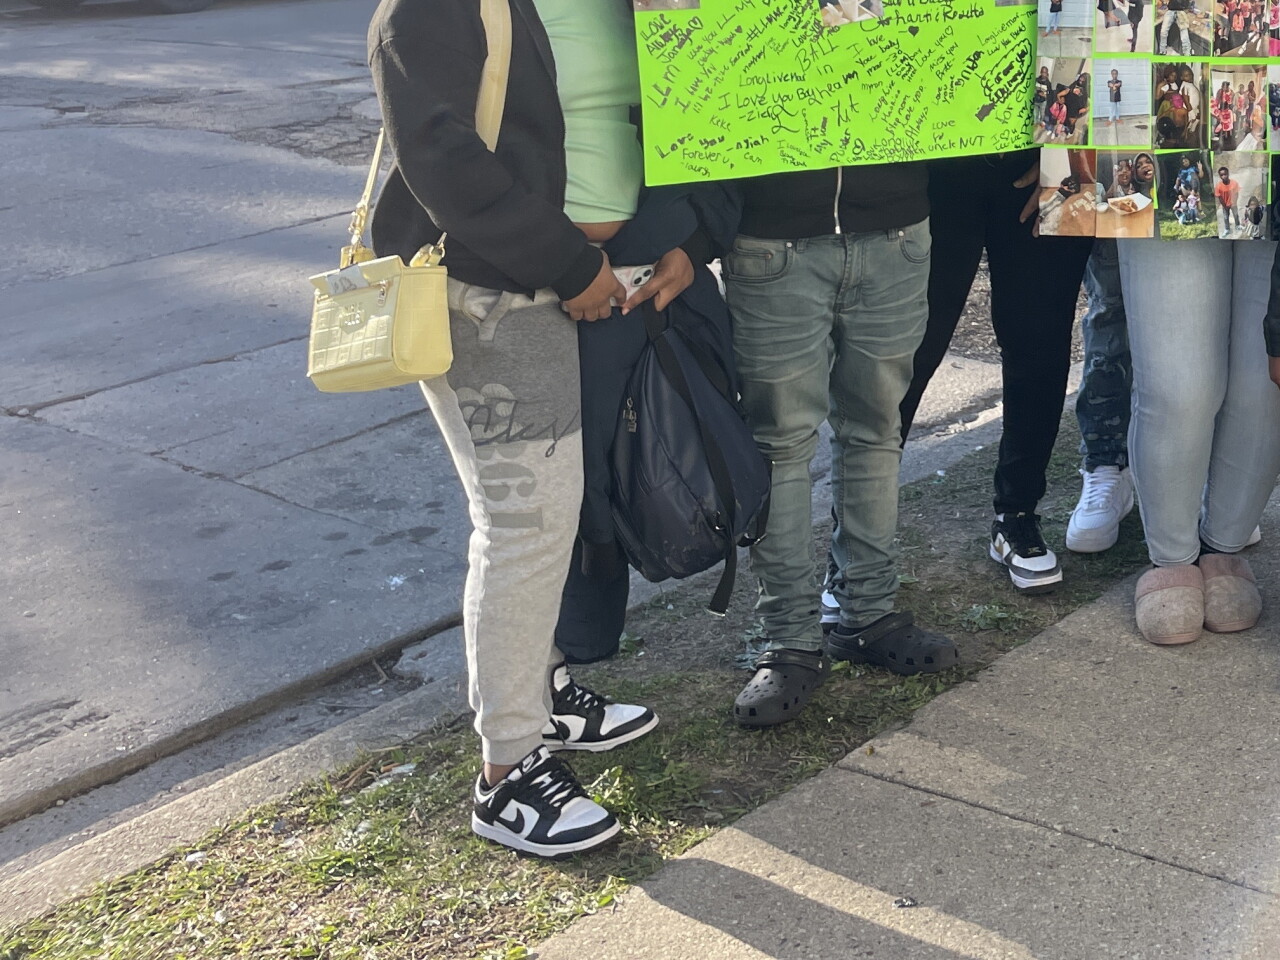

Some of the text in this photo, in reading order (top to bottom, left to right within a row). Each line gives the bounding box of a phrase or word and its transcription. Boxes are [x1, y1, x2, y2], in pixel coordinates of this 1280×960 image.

[736, 93, 768, 109] Love
[959, 134, 986, 150] NUT
[682, 147, 722, 162] Forever
